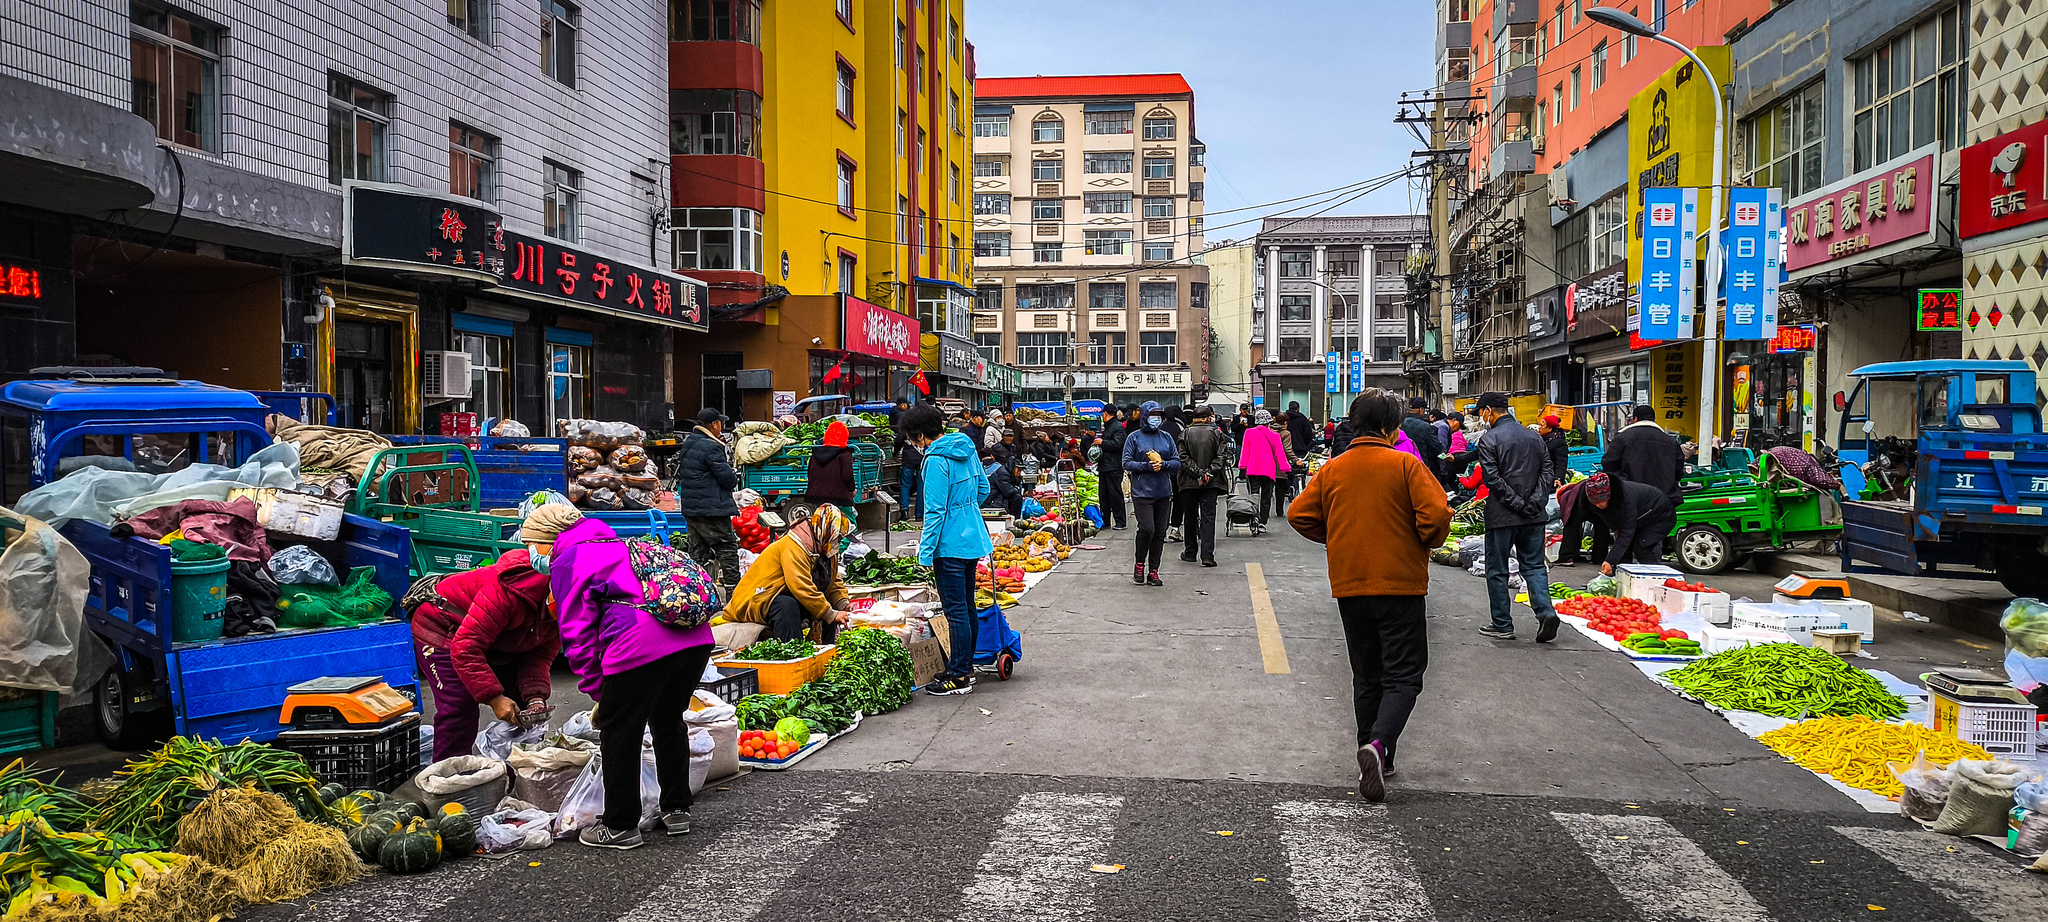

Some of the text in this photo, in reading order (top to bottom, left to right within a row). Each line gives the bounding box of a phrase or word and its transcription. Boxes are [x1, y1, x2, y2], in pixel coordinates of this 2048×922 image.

[1791, 167, 1917, 244] 双源家具城
[1990, 189, 2027, 217] 京东
[512, 242, 672, 316] 川号子火锅
[1648, 237, 1672, 325] 日丰管
[1680, 203, 1694, 324] 管用五十年
[1732, 236, 1756, 325] 日丰管
[1765, 202, 1779, 323] 管用五十年
[1922, 311, 1958, 328] 家具
[1923, 292, 1958, 309] 办公
[1771, 329, 1812, 350] 早餐包子
[1132, 373, 1183, 384] 可视采耳
[1956, 473, 2048, 492] 江苏
